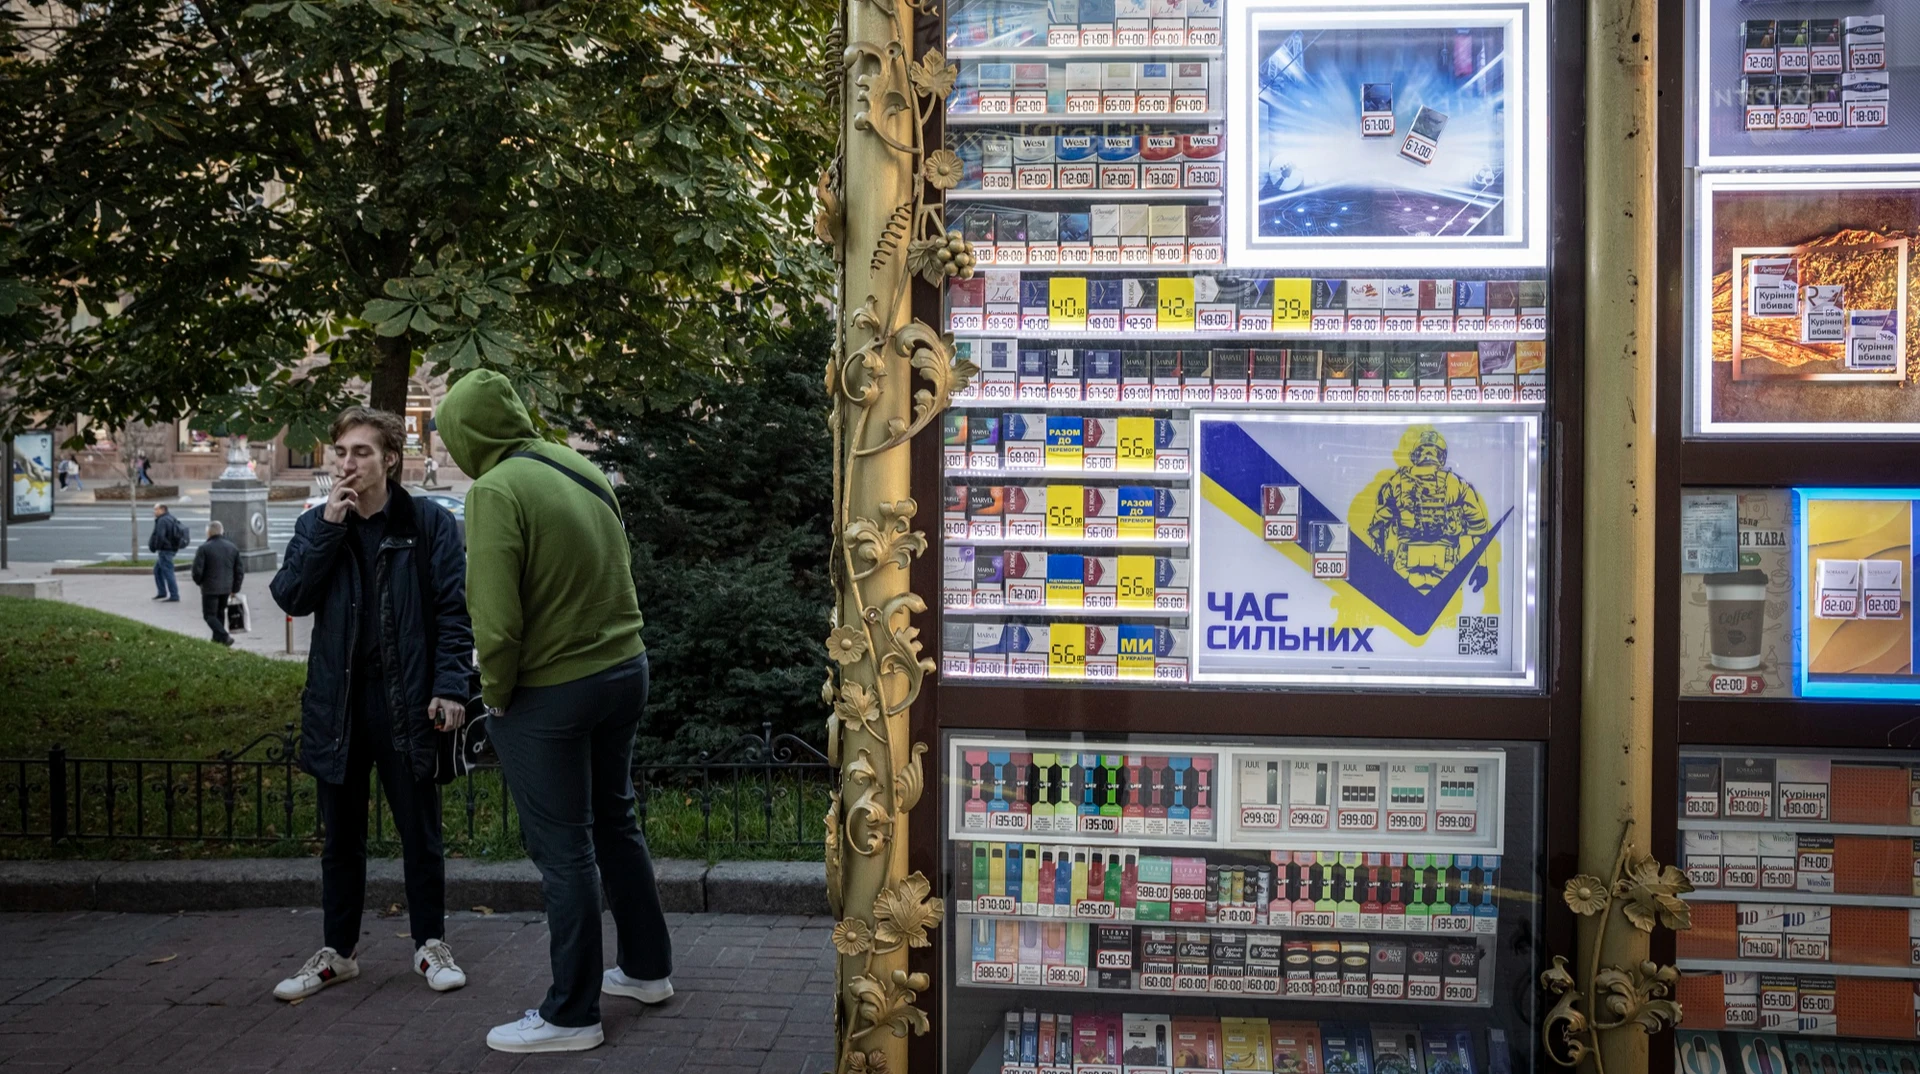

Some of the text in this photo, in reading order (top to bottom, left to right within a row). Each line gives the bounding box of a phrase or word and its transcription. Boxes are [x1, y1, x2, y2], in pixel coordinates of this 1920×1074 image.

[1023, 139, 1046, 148] West
[1064, 138, 1088, 147] West
[1107, 138, 1131, 146] West
[1149, 138, 1173, 146] West
[1191, 136, 1216, 145] West
[1759, 291, 1795, 302] Куріння
[1052, 297, 1076, 317] 40
[1160, 297, 1184, 317] 42
[1277, 298, 1301, 319] 39
[1760, 301, 1794, 310] вбиває
[1810, 318, 1842, 328] Куріння
[1812, 327, 1841, 335] вбиває
[1857, 342, 1894, 352] Куріння
[1858, 352, 1892, 361] вбиває
[1049, 429, 1081, 437] РАЗОМ
[1057, 437, 1072, 446] ДО
[1120, 437, 1145, 458] 56
[1049, 506, 1074, 527] 56
[1129, 508, 1144, 517] ДО
[1754, 531, 1787, 546] КАВА
[1120, 576, 1145, 597] 56
[1206, 592, 1289, 623] ЧАС
[1206, 625, 1375, 653] СИЛЬНИХ
[1121, 638, 1153, 653] МИ
[1052, 644, 1076, 664] 56
[1726, 787, 1771, 798] Куріння
[1781, 788, 1826, 799] Куріння
[1806, 877, 1831, 888] Winston
[1744, 910, 1759, 925] LD
[1791, 911, 1806, 927] LD
[1725, 971, 1737, 986] LD
[1767, 1013, 1780, 1028] LD
[1805, 1016, 1818, 1031] LD
